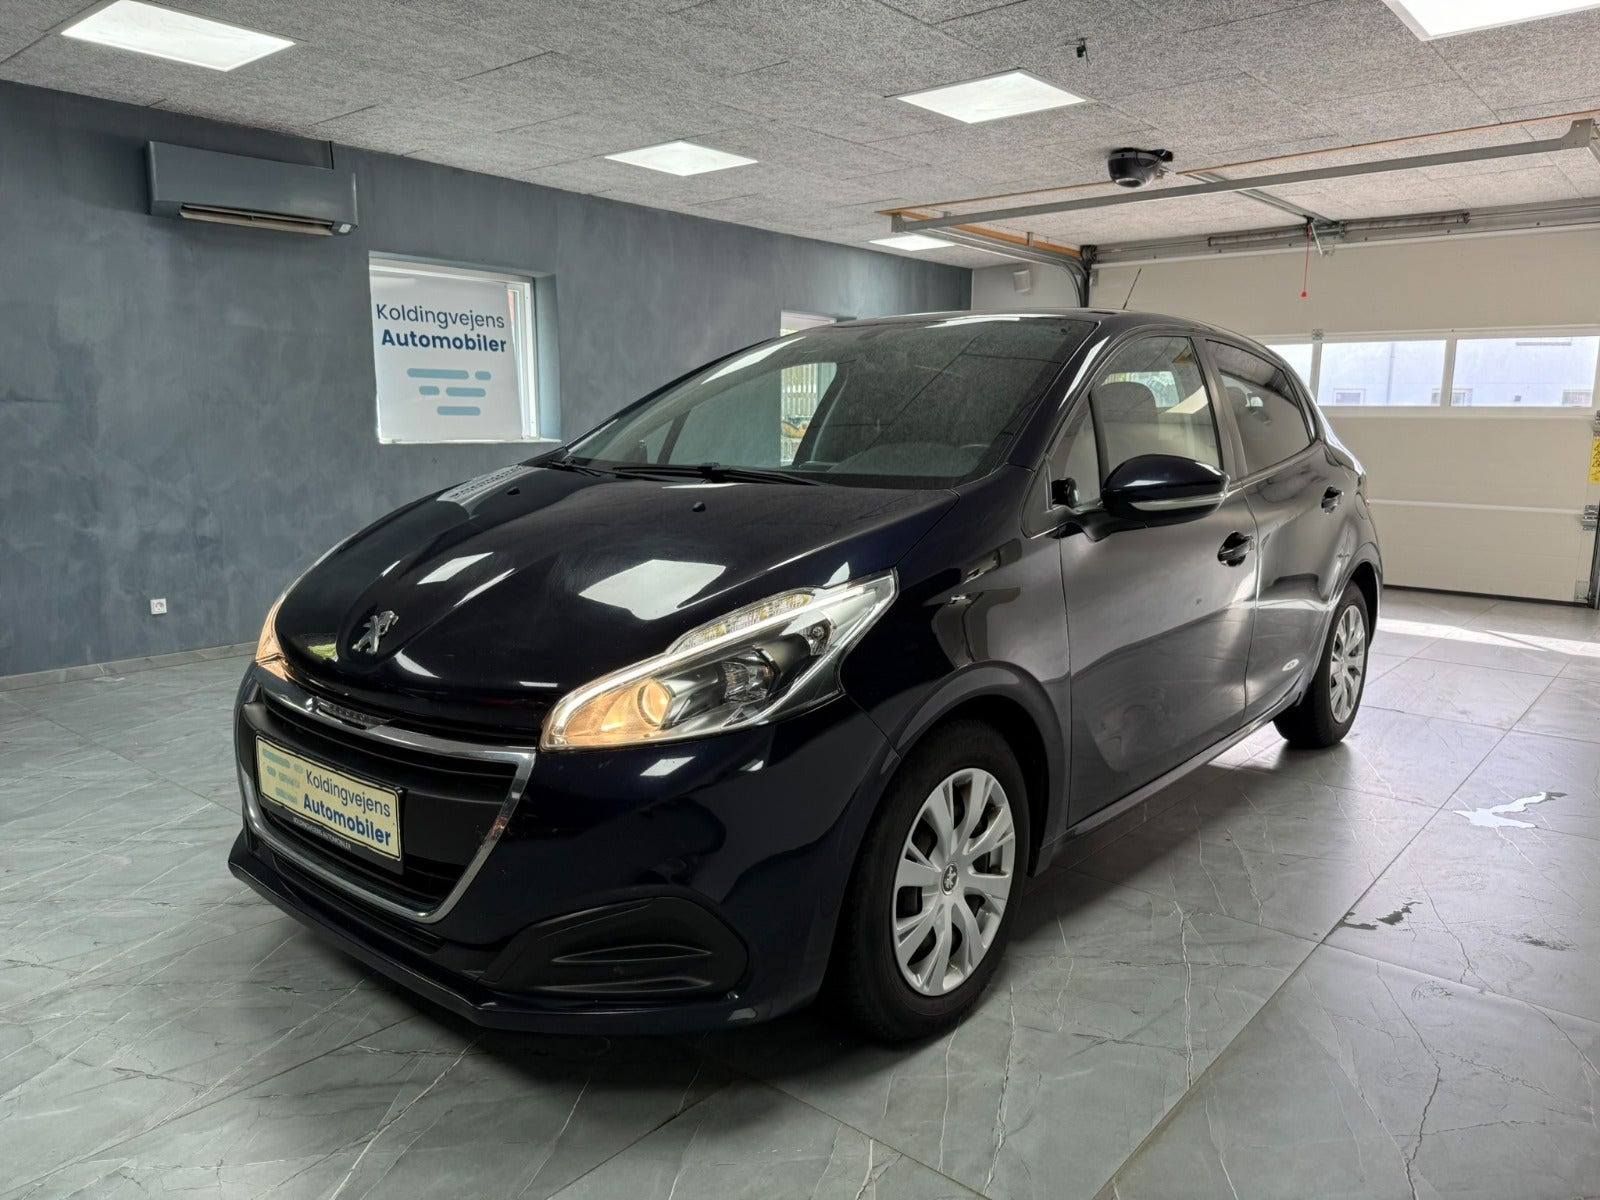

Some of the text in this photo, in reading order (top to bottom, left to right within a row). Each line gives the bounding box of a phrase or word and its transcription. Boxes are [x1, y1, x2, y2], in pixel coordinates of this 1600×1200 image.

[376, 304, 505, 331] Koldingvejens
[381, 329, 507, 352] Automobiler
[306, 769, 391, 817] Koldingvejens
[303, 793, 391, 846] Automobiler
